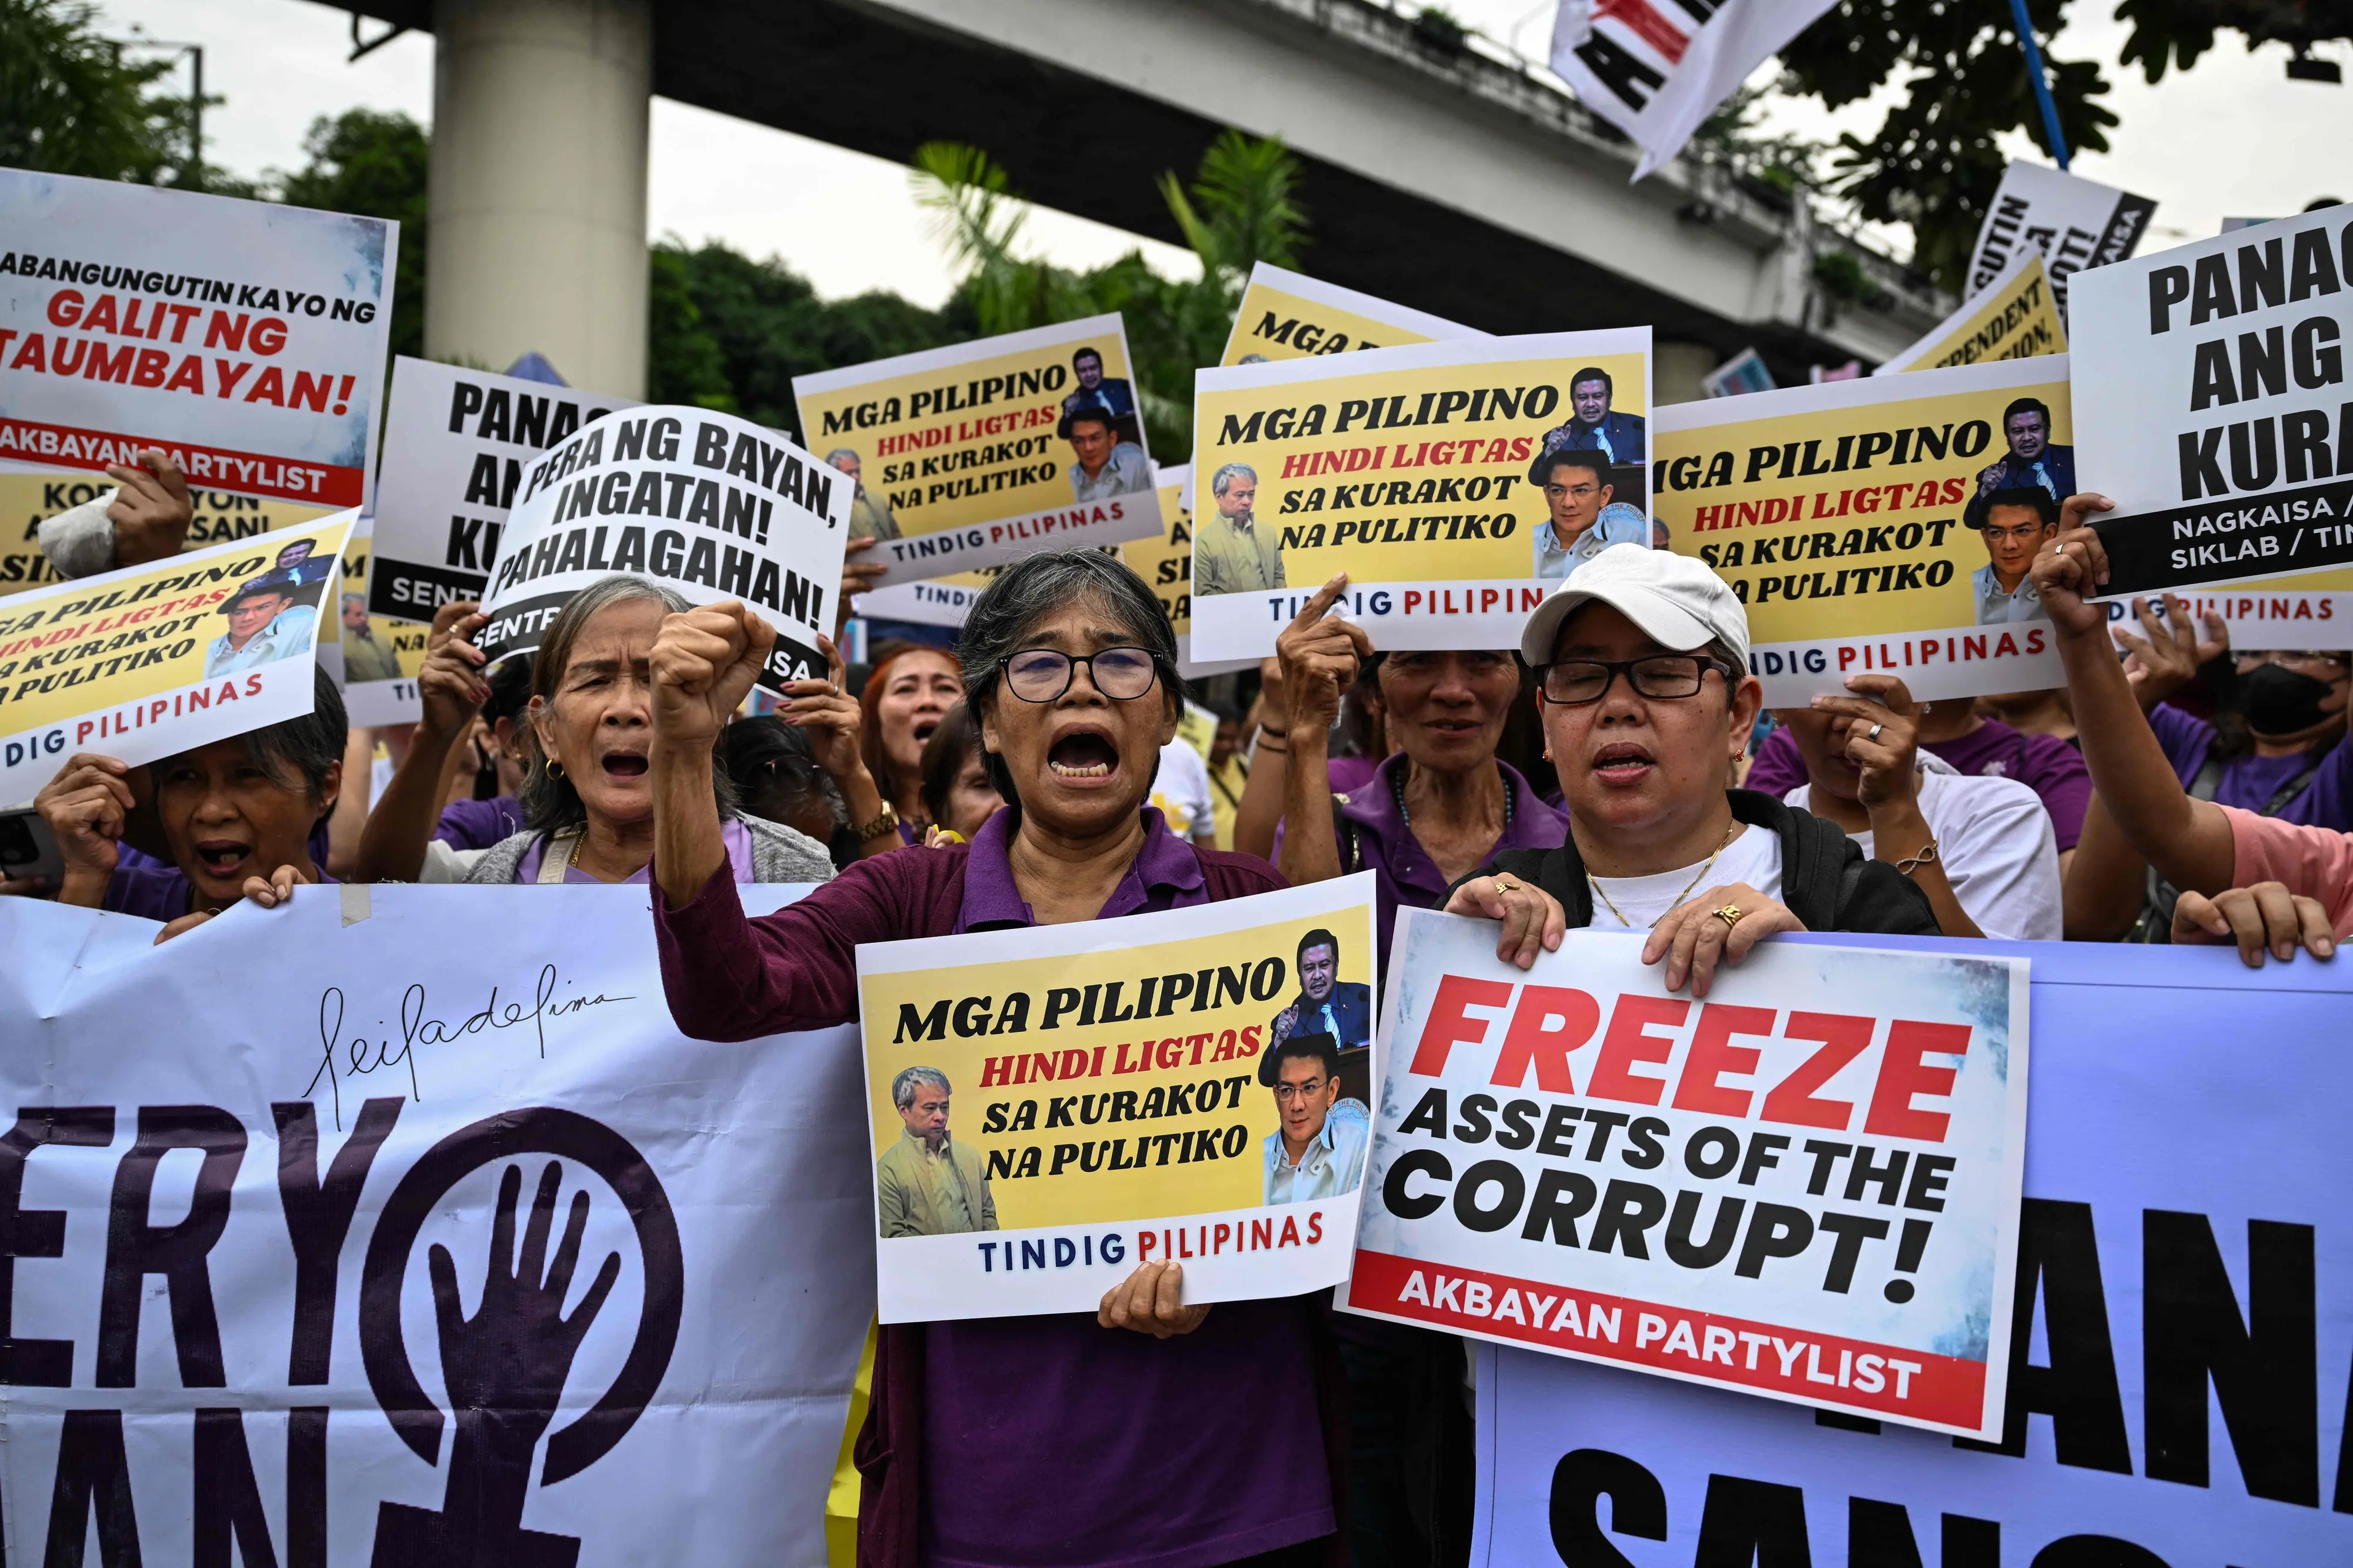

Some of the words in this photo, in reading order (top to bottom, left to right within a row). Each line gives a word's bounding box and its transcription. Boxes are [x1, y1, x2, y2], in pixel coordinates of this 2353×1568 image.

[237, 286, 326, 316] KAYO
[331, 301, 376, 323] NG
[2149, 220, 2353, 335] PANA
[47, 289, 202, 343] GALIT
[204, 309, 288, 356] NG
[1252, 311, 1348, 355] MGA
[0, 328, 356, 416] TAUMBAYAN!
[2190, 316, 2343, 412] ANG
[822, 398, 901, 436] MGA
[908, 364, 1067, 421] PILIPINO
[1217, 404, 1331, 446] MGA
[1332, 385, 1559, 433] PILIPINO
[0, 425, 138, 467] AKBAYAN
[876, 426, 952, 458] HINDI
[958, 404, 1055, 441] LIGTAS
[882, 463, 915, 484] SA
[920, 433, 1053, 478] KURAKOT
[1280, 445, 1389, 480] HINDI
[1391, 436, 1533, 468] LIGTAS
[1744, 419, 1992, 483] PILIPINO
[523, 428, 605, 506] PERA
[613, 417, 683, 463] NG
[694, 421, 836, 529] BAYAN,
[889, 489, 922, 512] NA
[927, 462, 1056, 505] PULITIKO
[1279, 486, 1327, 515] SA
[1330, 474, 1521, 509] KURAKOT
[552, 471, 773, 546] INGATAN!
[892, 531, 985, 563] TINDIG
[990, 502, 1124, 543] PILIPINAS
[1277, 522, 1326, 551] NA
[1332, 513, 1517, 548] PULITIKO
[1693, 495, 1806, 532] HINDI
[1811, 477, 1966, 519] LIGTAS
[2173, 497, 2335, 540] NAGKAISA
[1699, 541, 1744, 569] SA
[1751, 519, 1956, 566] KURAKOT
[2171, 535, 2280, 569] SIKLAB
[45, 556, 266, 625] PILIPINO
[489, 525, 824, 632] PAHALAGAHAN!
[1269, 592, 1392, 621] TIIG
[1405, 588, 1544, 614] PILIPIN
[1757, 559, 1954, 603] PULITIKO
[91, 588, 231, 635] LIGTAS
[11, 639, 196, 702] PULITIKO
[19, 612, 209, 675] KURAKOT
[1838, 628, 2046, 672] PILIPINAS
[76, 673, 263, 745] PILIPINAS
[892, 992, 1031, 1044] MGA
[1040, 956, 1286, 1030] PILIPINO
[979, 1046, 1107, 1087] HINDI
[1112, 1025, 1262, 1075] LIGTAS
[1409, 973, 1972, 1142] FREEZE
[982, 1101, 1041, 1134] SA
[1044, 1075, 1251, 1129] KURAKOT
[984, 1147, 1042, 1181] NA
[1049, 1124, 1248, 1175] PULITIKO
[1397, 1087, 1671, 1170] ASSETS
[1684, 1126, 1788, 1187] OF
[1802, 1139, 1957, 1213] THE
[979, 1234, 1125, 1272] TINDIG
[1139, 1211, 1324, 1262] PILIPINAS
[1382, 1149, 1934, 1305] CORRUPT!
[1397, 1269, 1622, 1345] AKBAYAN
[1636, 1312, 1921, 1399] PARTYLIST
